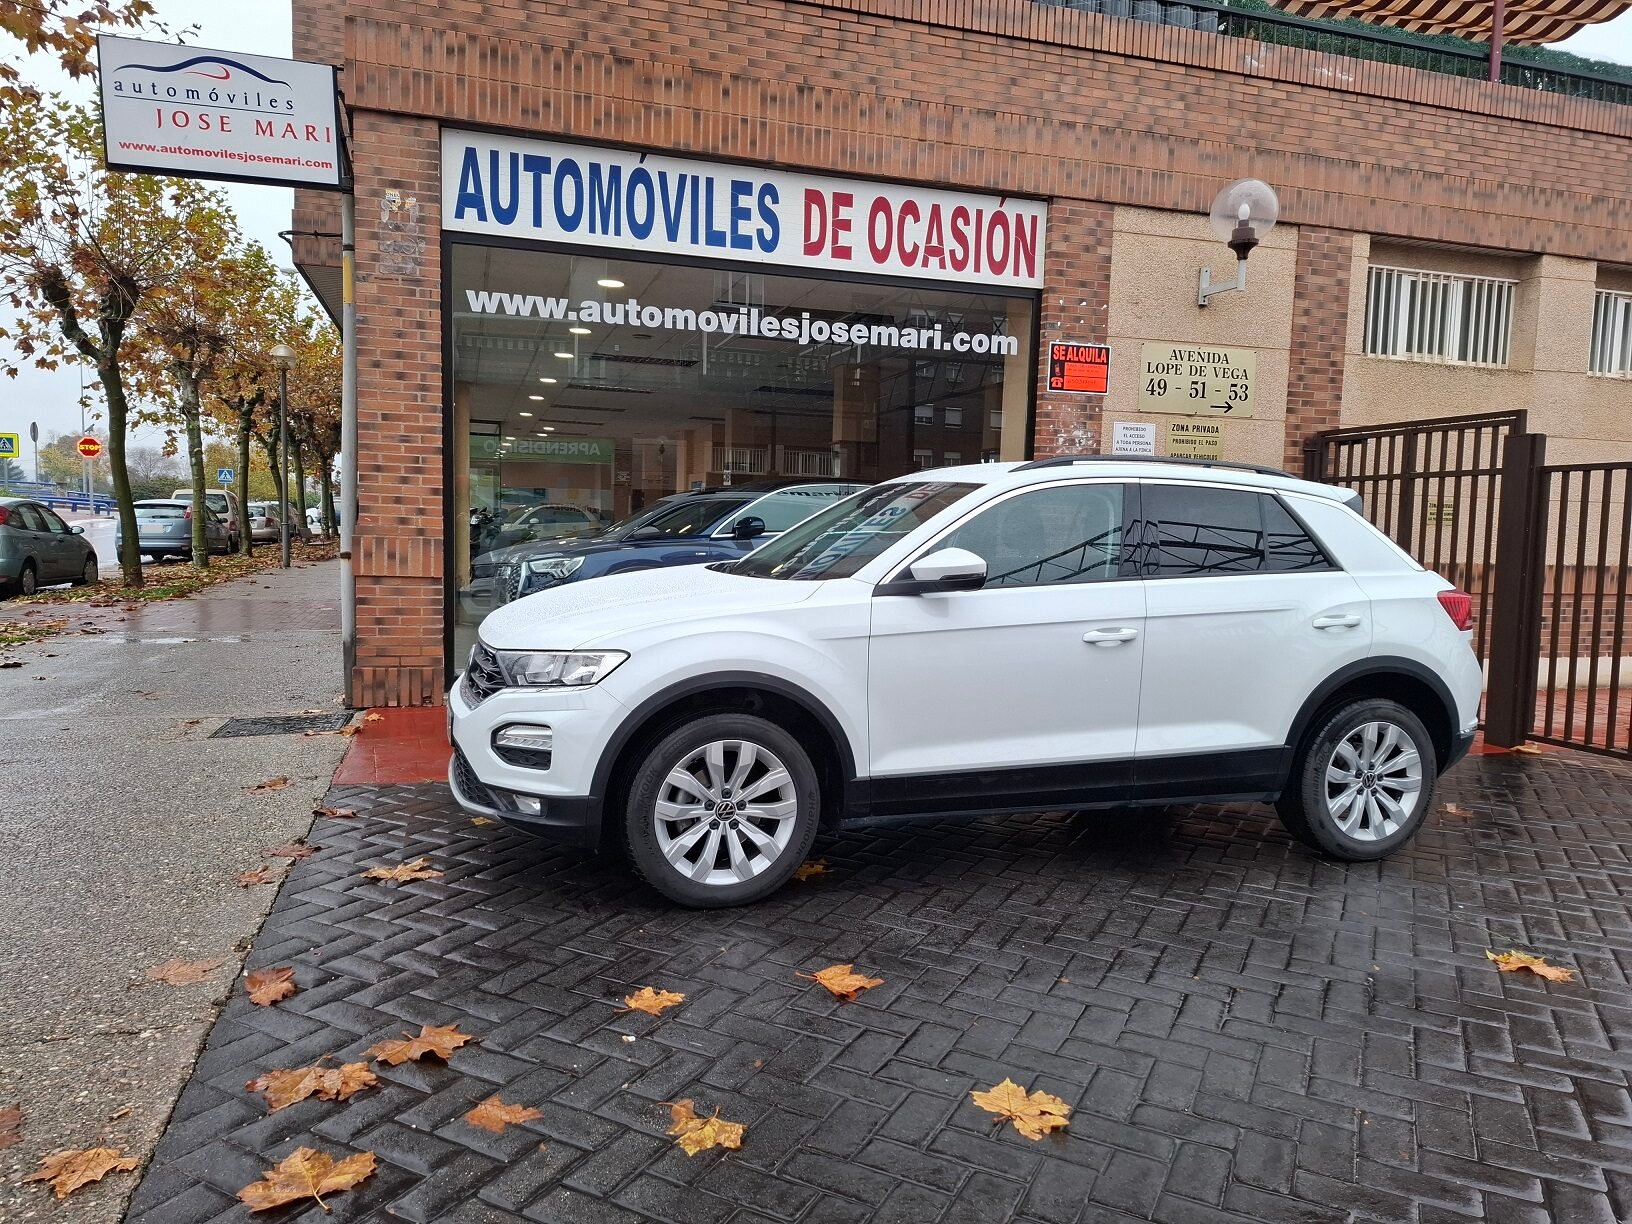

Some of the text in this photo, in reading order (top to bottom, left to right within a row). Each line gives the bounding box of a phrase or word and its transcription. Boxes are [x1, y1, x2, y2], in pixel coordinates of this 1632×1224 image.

[114, 79, 293, 110] automóviles
[156, 108, 332, 143] JOSE MARI
[119, 140, 333, 169] www.automovilesjosemari.com
[454, 146, 1037, 279] AUTOMÓVILES DE OCASIÓN
[466, 289, 1018, 355] www.automovilesjosemari.com
[1053, 345, 1107, 363] SE ALQUILA
[1169, 349, 1230, 365] AVENIDA
[1146, 362, 1249, 380] LOPE DE VEGA
[1145, 378, 1168, 396] 49
[1189, 380, 1207, 399] 51
[1228, 382, 1249, 402] 53
[1171, 423, 1220, 434] ZONA PRIVADA
